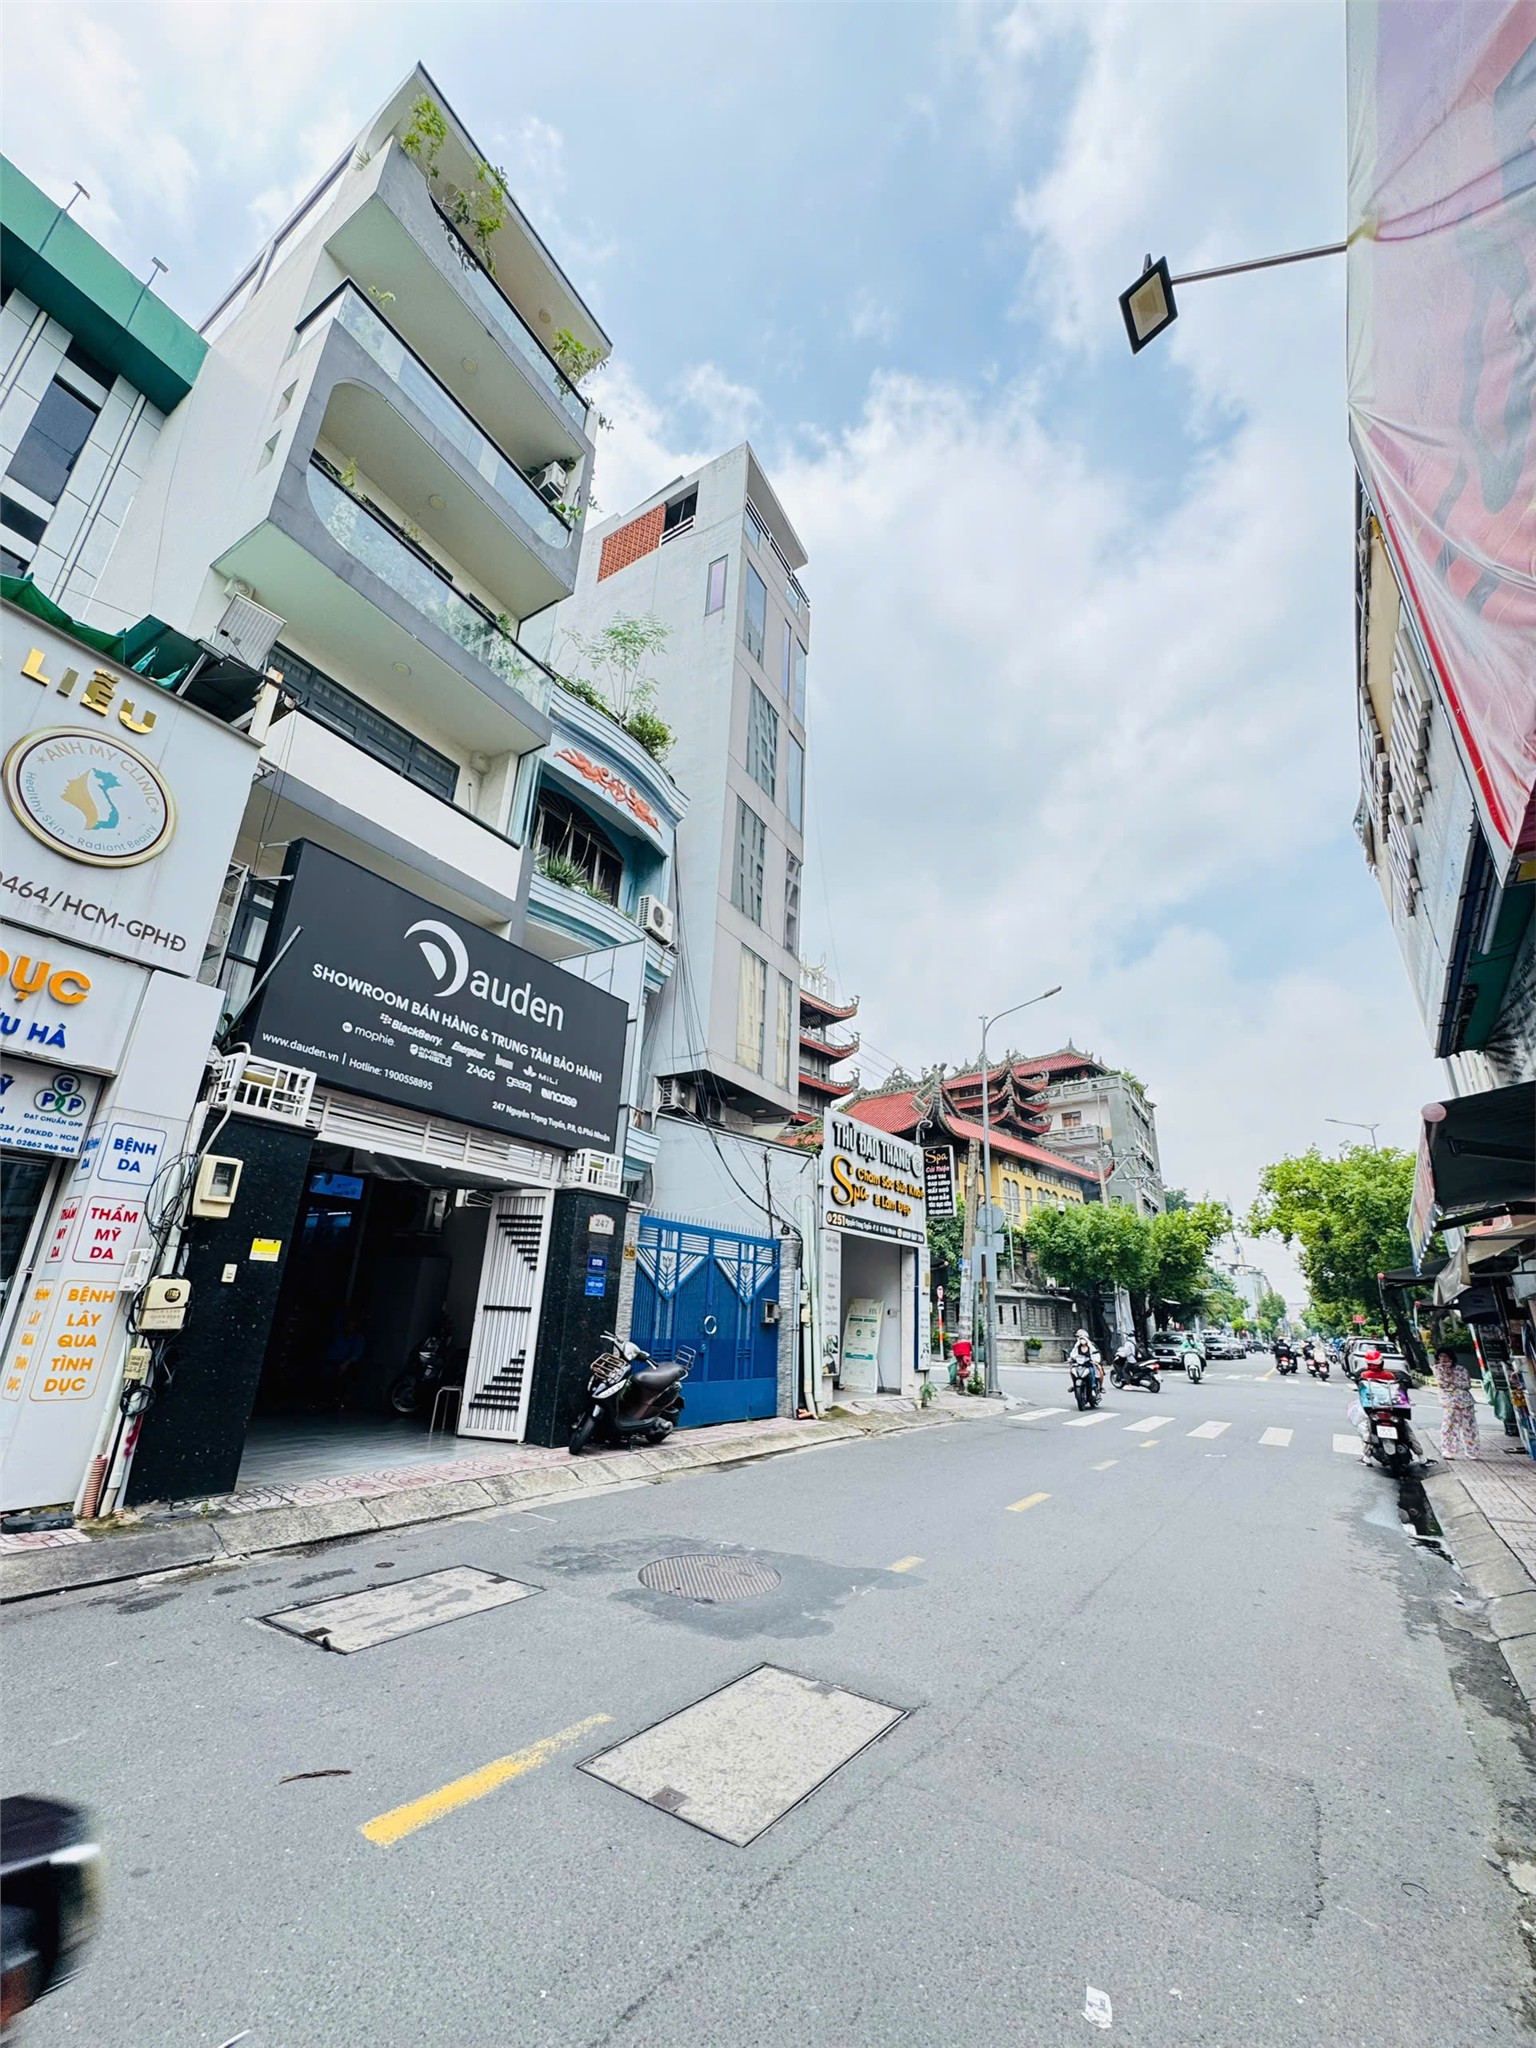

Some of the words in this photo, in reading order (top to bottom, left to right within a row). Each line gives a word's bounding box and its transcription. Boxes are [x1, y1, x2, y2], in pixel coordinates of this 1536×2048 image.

[45, 741, 83, 762] ANH
[119, 759, 160, 808] CLINIC
[25, 771, 45, 815] Healthy
[41, 814, 66, 837] Skin
[77, 837, 127, 853] Radiant
[126, 824, 157, 849] Beauty
[0, 871, 187, 952] 464/HCM-GPHĐ
[312, 963, 410, 1012] SHOWROOM
[411, 1001, 440, 1023] BÁN
[441, 1013, 480, 1038] HÀNG
[480, 1028, 490, 1042] &
[491, 1031, 529, 1057] TRUNG
[575, 1063, 603, 1084] HÀNH
[26, 1022, 67, 1049] HÀ
[262, 1032, 340, 1063] www.dauden.vn
[348, 1057, 382, 1077] Hotline:
[384, 1068, 434, 1092] 1900558895
[417, 1051, 453, 1068] SHIELD
[466, 1062, 496, 1082] ZAGG
[492, 1100, 506, 1111] 247
[59, 1133, 80, 1142] HCM
[113, 1136, 158, 1155] BỆNH
[924, 1148, 949, 1165] Spa
[117, 1159, 141, 1173] DA
[91, 1203, 139, 1224] THẨM
[594, 1218, 610, 1229] 247
[94, 1226, 122, 1242] MỸ
[89, 1246, 114, 1260] DA
[67, 1286, 117, 1306] BỆNH
[66, 1310, 102, 1327] LÂY
[57, 1333, 97, 1348] QUA
[51, 1354, 94, 1372] TÌNH
[43, 1377, 87, 1396] DỤC
